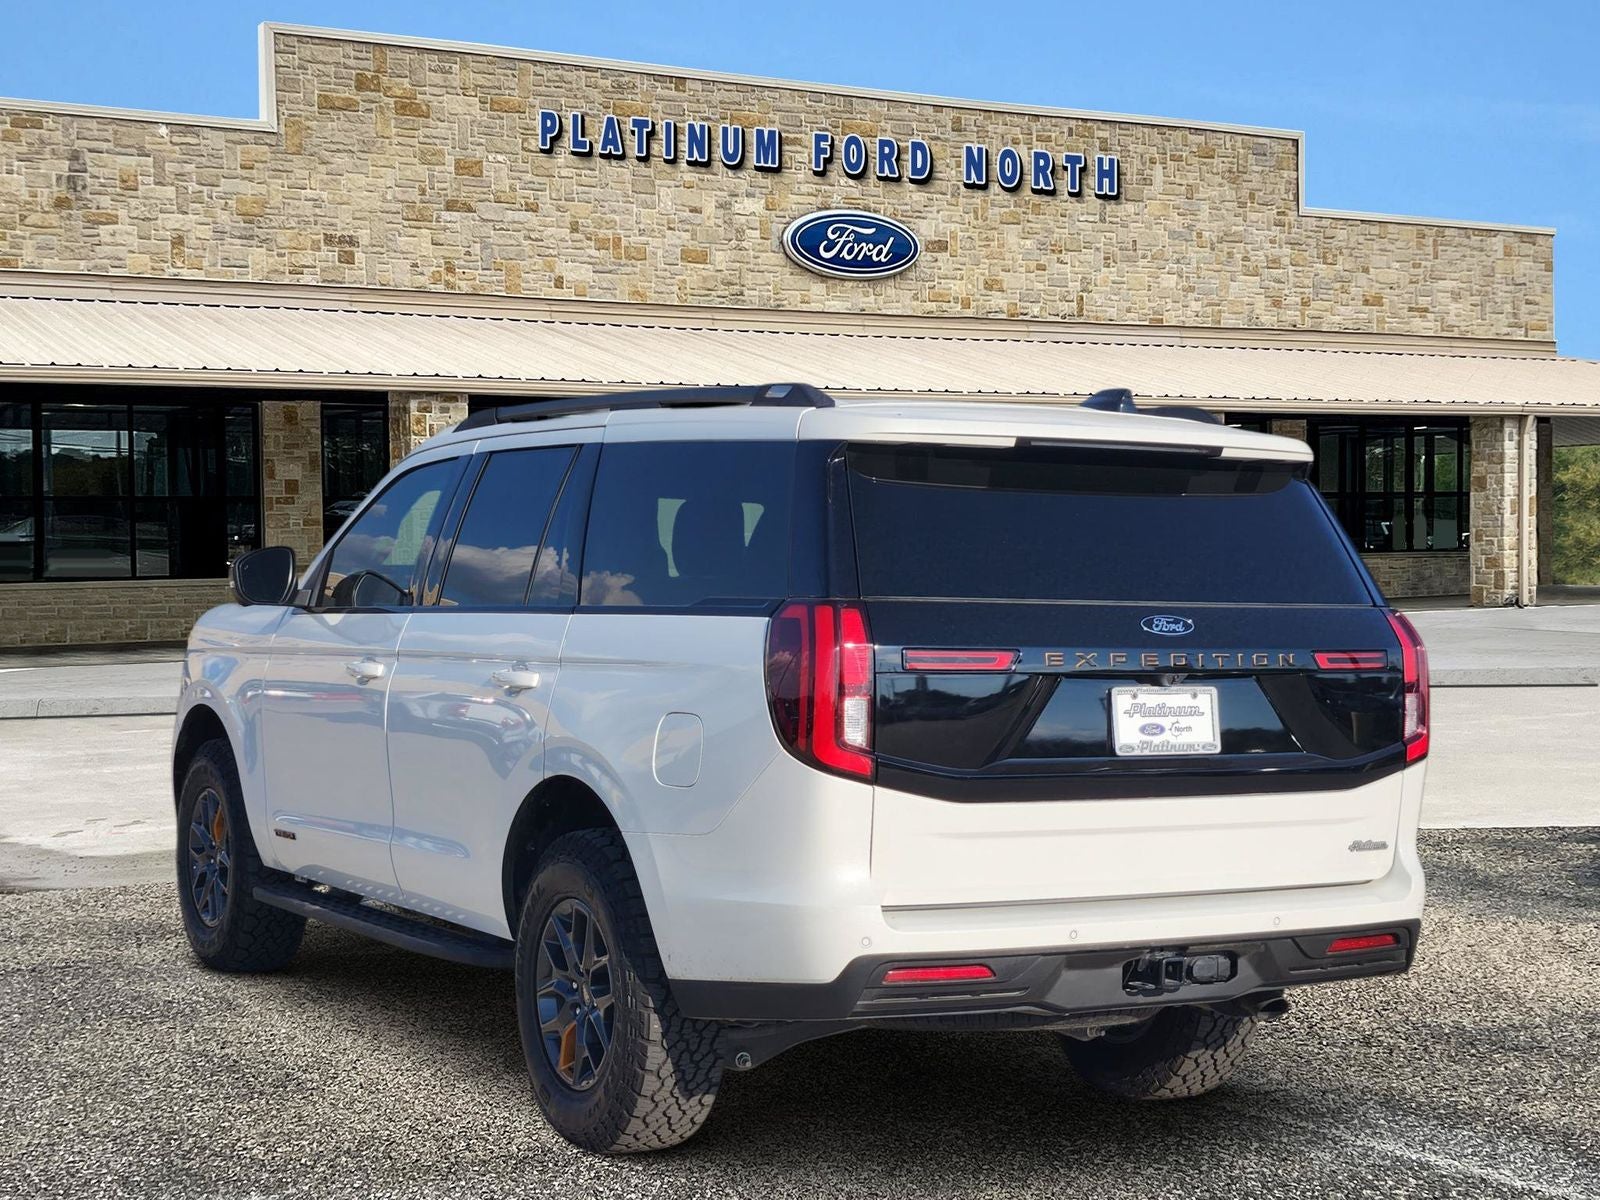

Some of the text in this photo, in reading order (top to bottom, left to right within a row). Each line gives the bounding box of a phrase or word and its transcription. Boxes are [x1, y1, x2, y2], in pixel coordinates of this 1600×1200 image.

[539, 109, 1121, 199] PLATINUM FORD NORTH
[818, 223, 894, 263] Ford
[1152, 617, 1186, 633] Ford
[1044, 652, 1297, 668] EXPEDITION
[1123, 702, 1205, 718] Platinum
[1174, 724, 1193, 733] North
[1136, 740, 1200, 754] Platinum
